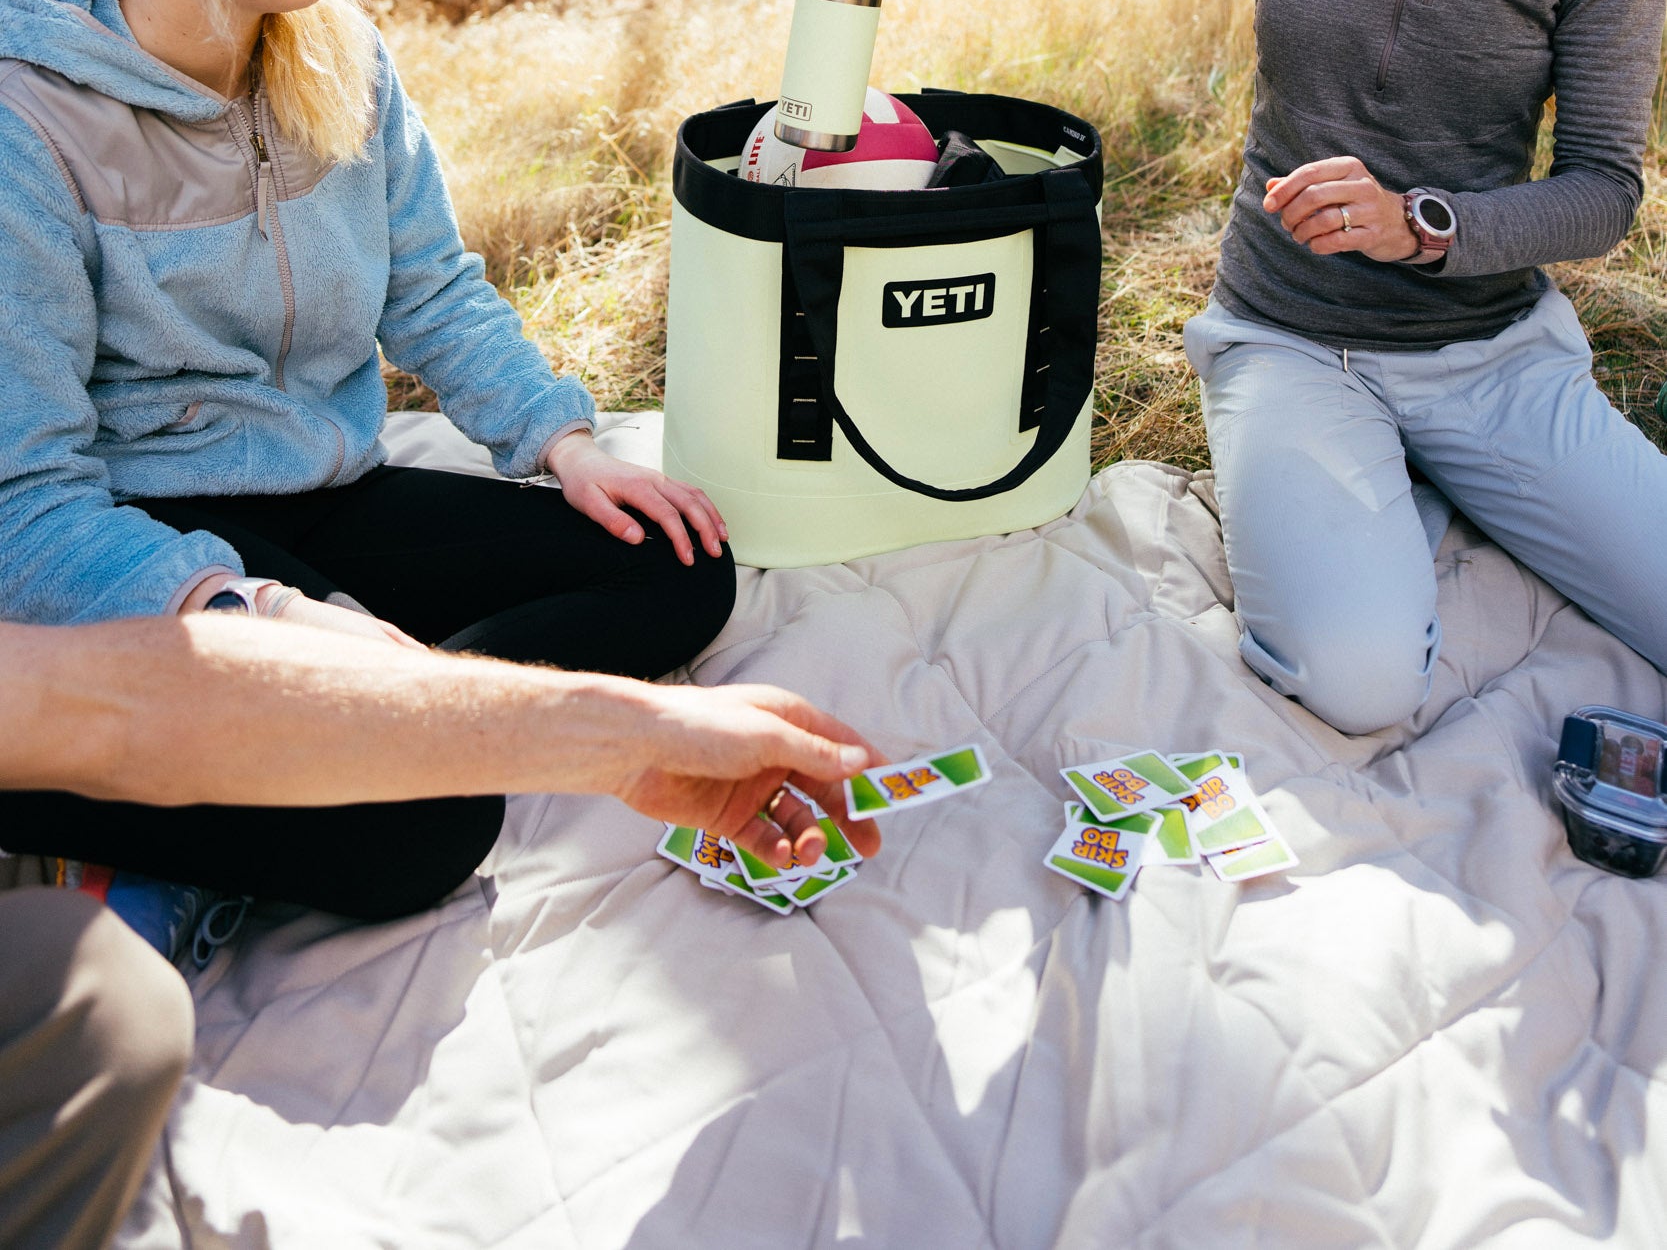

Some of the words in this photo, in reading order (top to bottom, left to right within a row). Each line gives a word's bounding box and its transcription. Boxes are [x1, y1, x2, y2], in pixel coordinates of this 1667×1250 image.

[781, 99, 808, 117] YETI
[748, 136, 765, 165] LITE
[892, 283, 985, 318] YETI
[1112, 769, 1150, 792] BO
[1200, 794, 1236, 820] BO
[1081, 827, 1120, 850] BO
